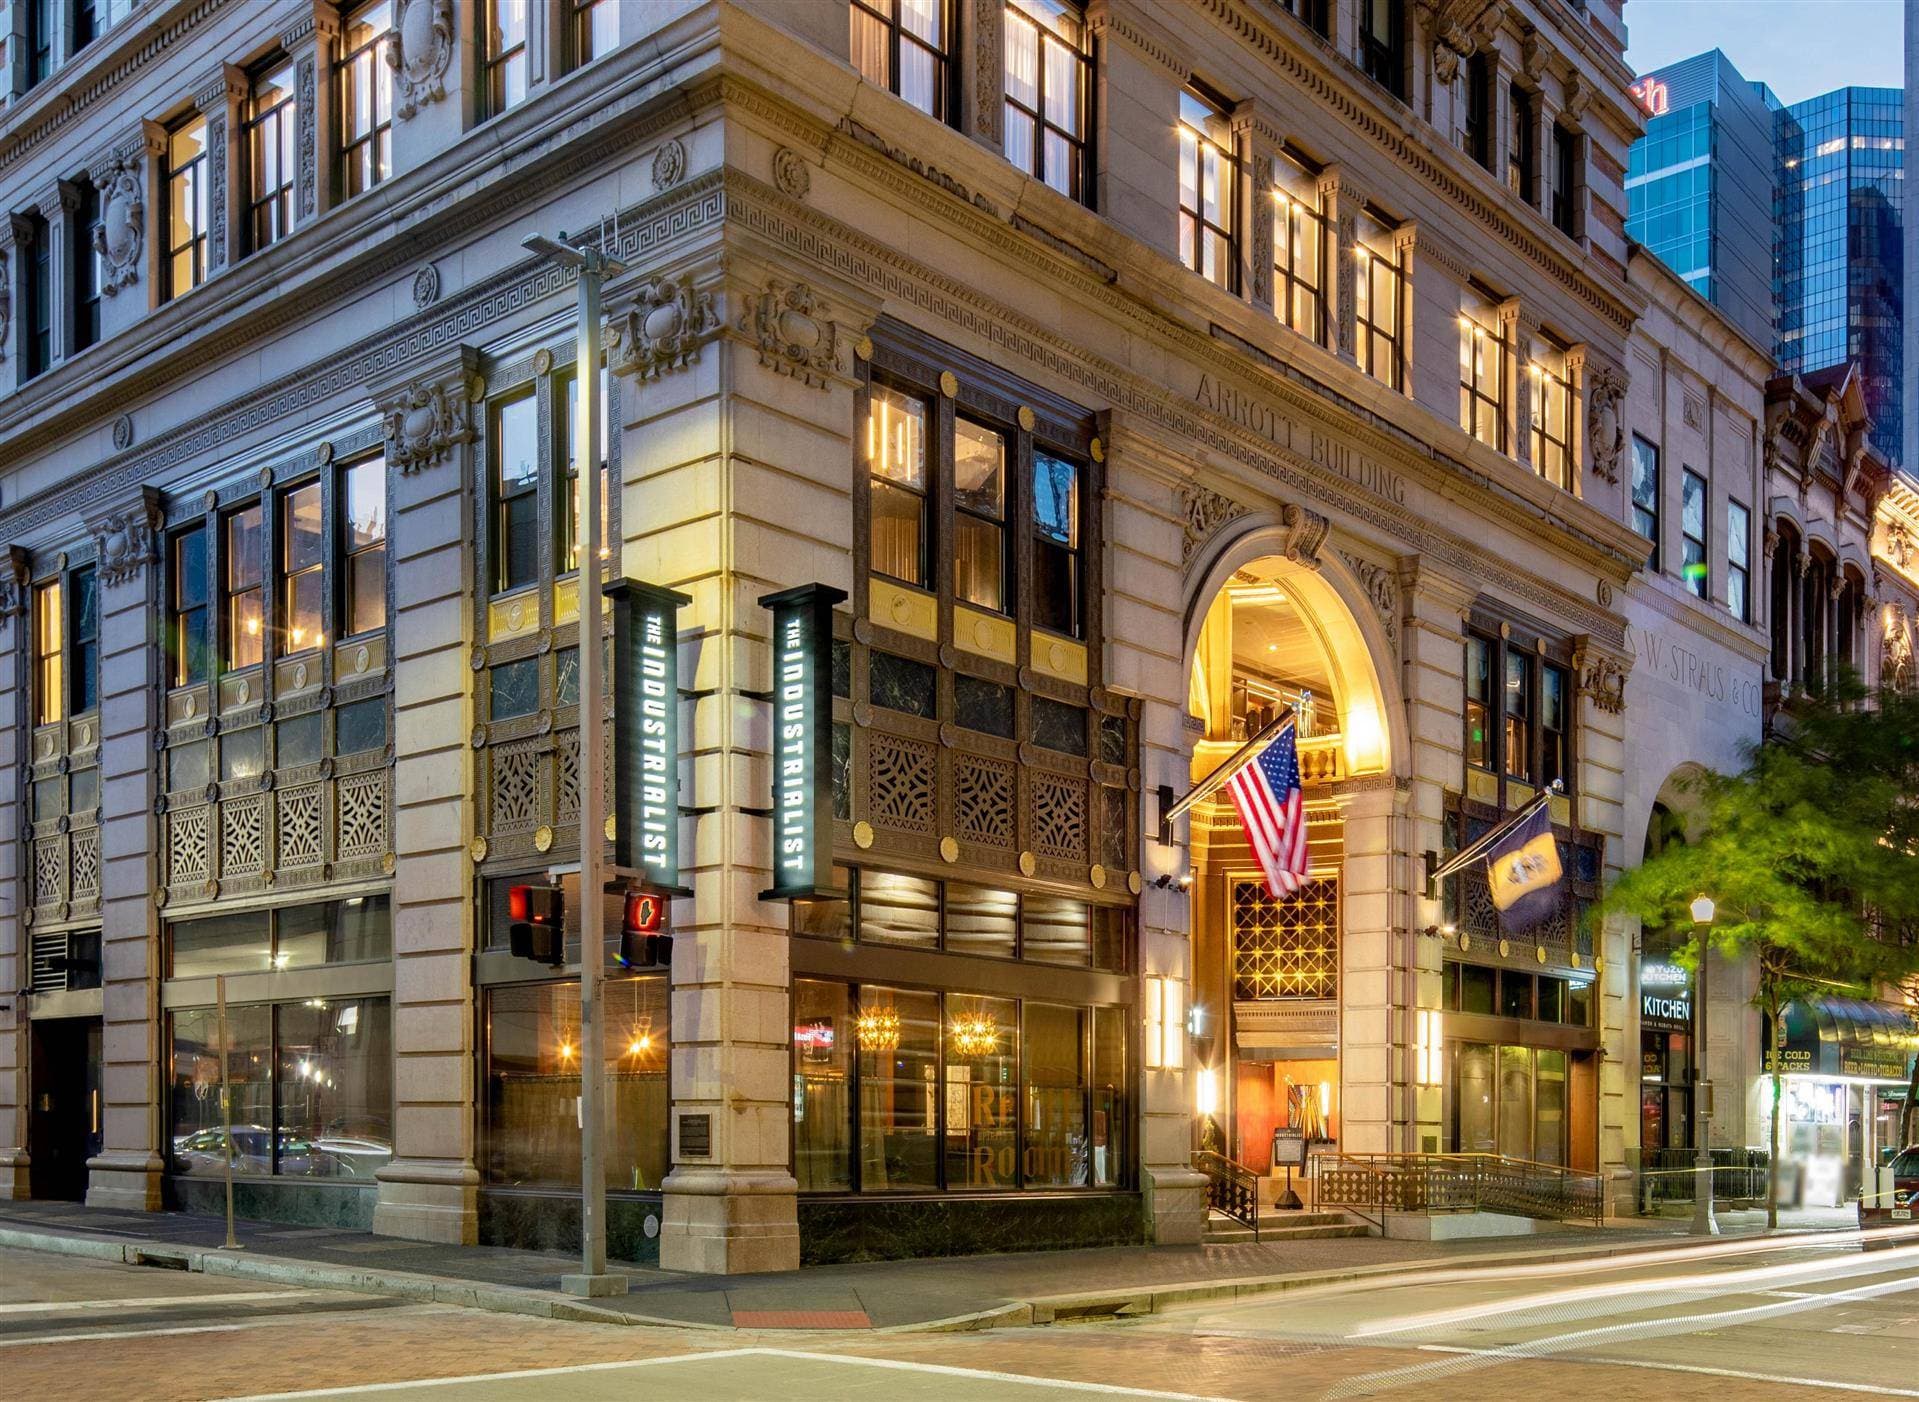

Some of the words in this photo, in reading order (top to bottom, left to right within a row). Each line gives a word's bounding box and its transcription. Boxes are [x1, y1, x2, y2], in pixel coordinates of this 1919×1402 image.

[1196, 374, 1298, 449] ARROTT
[1310, 430, 1405, 506] BUILDING
[647, 616, 661, 645] THE
[786, 619, 800, 647] THE
[1670, 645, 1725, 702] STRAUS
[1731, 678, 1739, 705] &
[1742, 680, 1760, 718] CO
[642, 646, 666, 868] INDUSTRIALIST
[783, 651, 804, 870] INDUSTRIALIST
[1644, 996, 1690, 1021] KITCHEN
[1785, 1051, 1811, 1060] COLD
